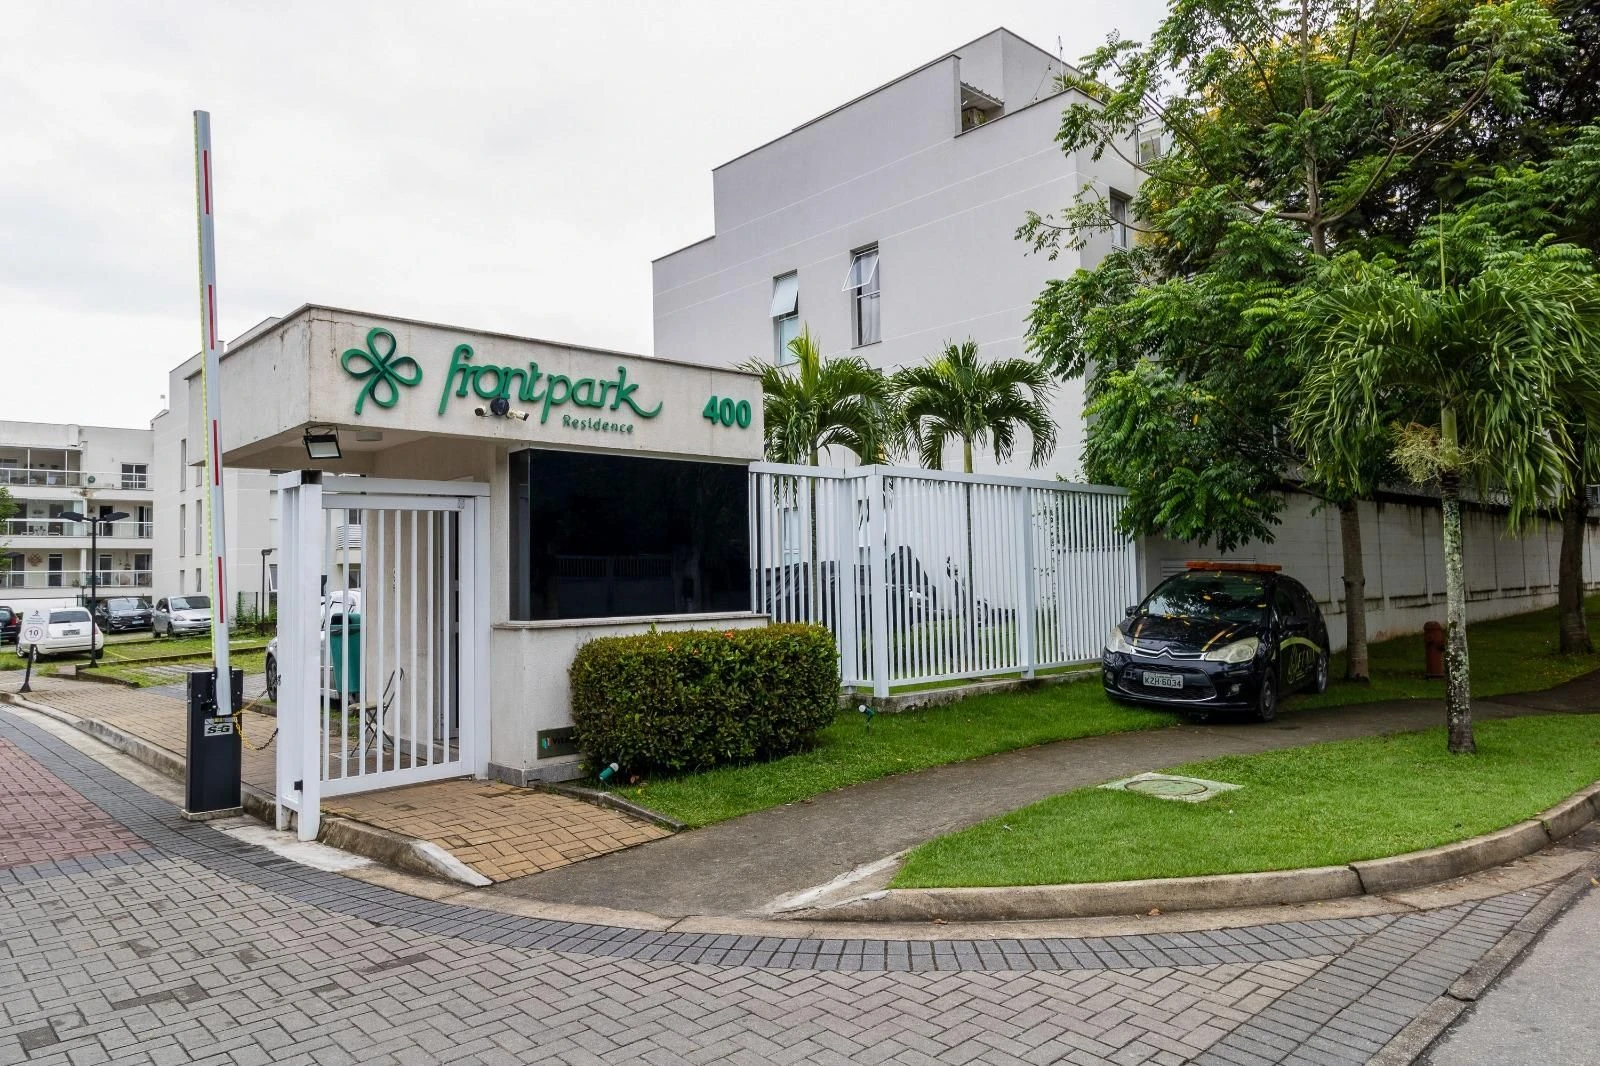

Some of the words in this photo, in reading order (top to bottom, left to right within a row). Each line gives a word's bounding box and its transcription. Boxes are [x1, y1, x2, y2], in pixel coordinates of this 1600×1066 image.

[438, 343, 664, 425] frontpark
[562, 414, 635, 434] Residence
[702, 395, 752, 429] 400
[28, 629, 39, 637] 10
